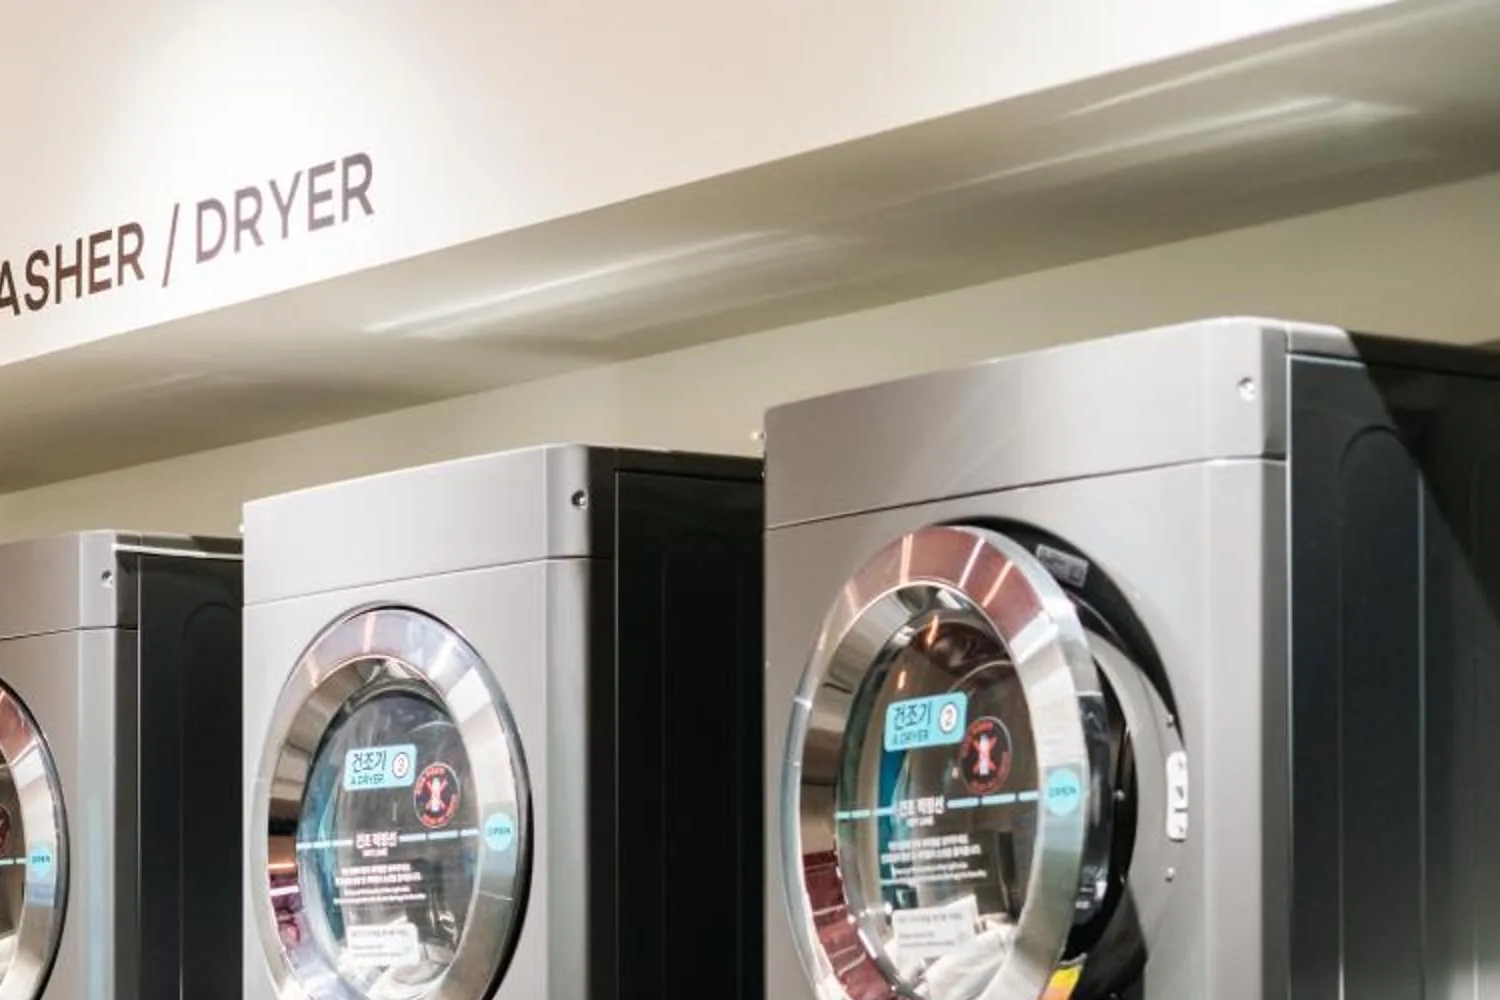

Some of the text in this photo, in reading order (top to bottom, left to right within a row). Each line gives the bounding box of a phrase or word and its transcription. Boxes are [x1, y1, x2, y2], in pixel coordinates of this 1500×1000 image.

[162, 203, 180, 288] /
[196, 151, 375, 265] DRYER
[894, 701, 932, 731] 건조기
[352, 750, 386, 773] 건조기
